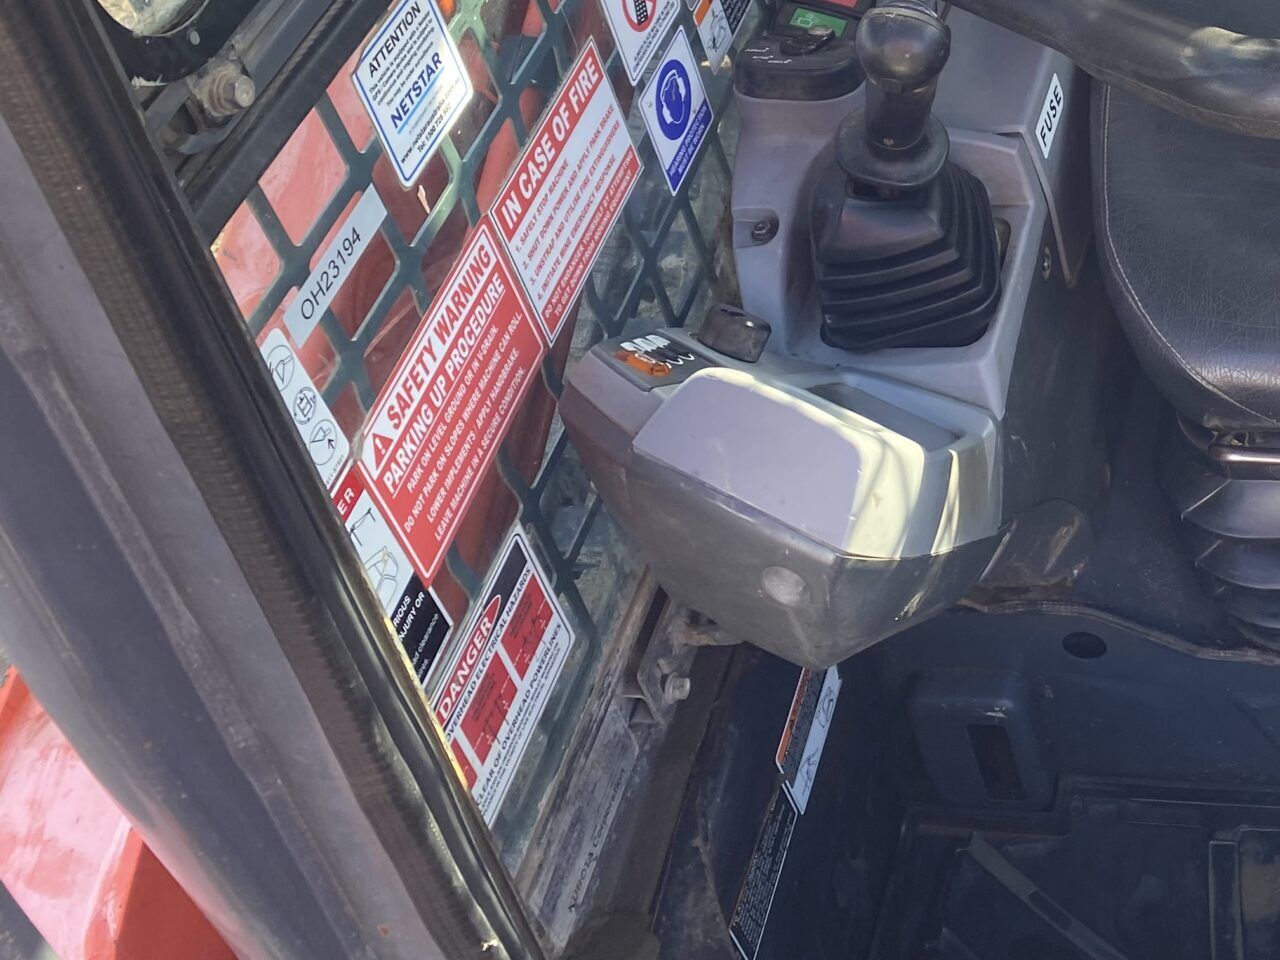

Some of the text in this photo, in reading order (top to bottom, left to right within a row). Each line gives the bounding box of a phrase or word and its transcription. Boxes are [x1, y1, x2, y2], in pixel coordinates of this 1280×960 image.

[366, 0, 421, 78] ATTENTION
[389, 49, 443, 129] NETSTAR
[1040, 85, 1062, 148] FUSE
[500, 53, 599, 232] IN CASE OF FIRE
[519, 212, 538, 247] SAFELY
[536, 191, 549, 217] STOP
[547, 157, 568, 196] MACHINE
[527, 236, 541, 263] SHUT
[539, 212, 554, 240] DOWN
[552, 185, 569, 217] POWER
[567, 168, 578, 190] AND
[576, 144, 591, 172] APPLY
[589, 126, 601, 150] PARK
[599, 102, 614, 130] BRAKE
[534, 236, 556, 278] UNSTRAP
[554, 219, 565, 241] AND
[563, 190, 581, 224] UTILISE
[579, 172, 590, 195] FIRE
[588, 117, 620, 178] EXTINGUISHERS
[541, 255, 561, 294] INITIATE
[559, 235, 572, 260] MINE
[570, 189, 596, 240] EMERGENCY
[594, 152, 615, 194] RESPONSE
[298, 223, 362, 324] OH23194
[544, 149, 633, 319] DO NOT ENDANGER YOURSELF BY ATTEMPTING
[554, 167, 632, 318] TO GET DOWN FROM MOVING EQUIPMENT
[382, 270, 505, 496] PARKING UP PROCEDURE
[384, 241, 492, 434] SAFETY WARNING
[406, 321, 499, 495] PARK ON LEVEL GROUND OR IN V-DRAIN.
[403, 307, 522, 534] DO NOT PARK ON SLOPES WHERE MACHINE CAN ROLL.
[426, 343, 519, 525] LOWER IMPLEMENTS APPLY HANDBRAKE.
[434, 505, 453, 543] LEAVE
[449, 464, 474, 512] MACHINE
[471, 452, 480, 470] IN
[480, 410, 501, 451] SECURE
[498, 362, 525, 416] CONDITION.
[414, 591, 425, 609] OR
[438, 612, 492, 722] DANGER
[445, 677, 477, 743] OVERHEAD
[474, 614, 507, 681] ELECTRICAL
[505, 565, 530, 618] HAZARDS
[475, 620, 561, 808] CLEAR OF OVERHEAD POWERLINES
